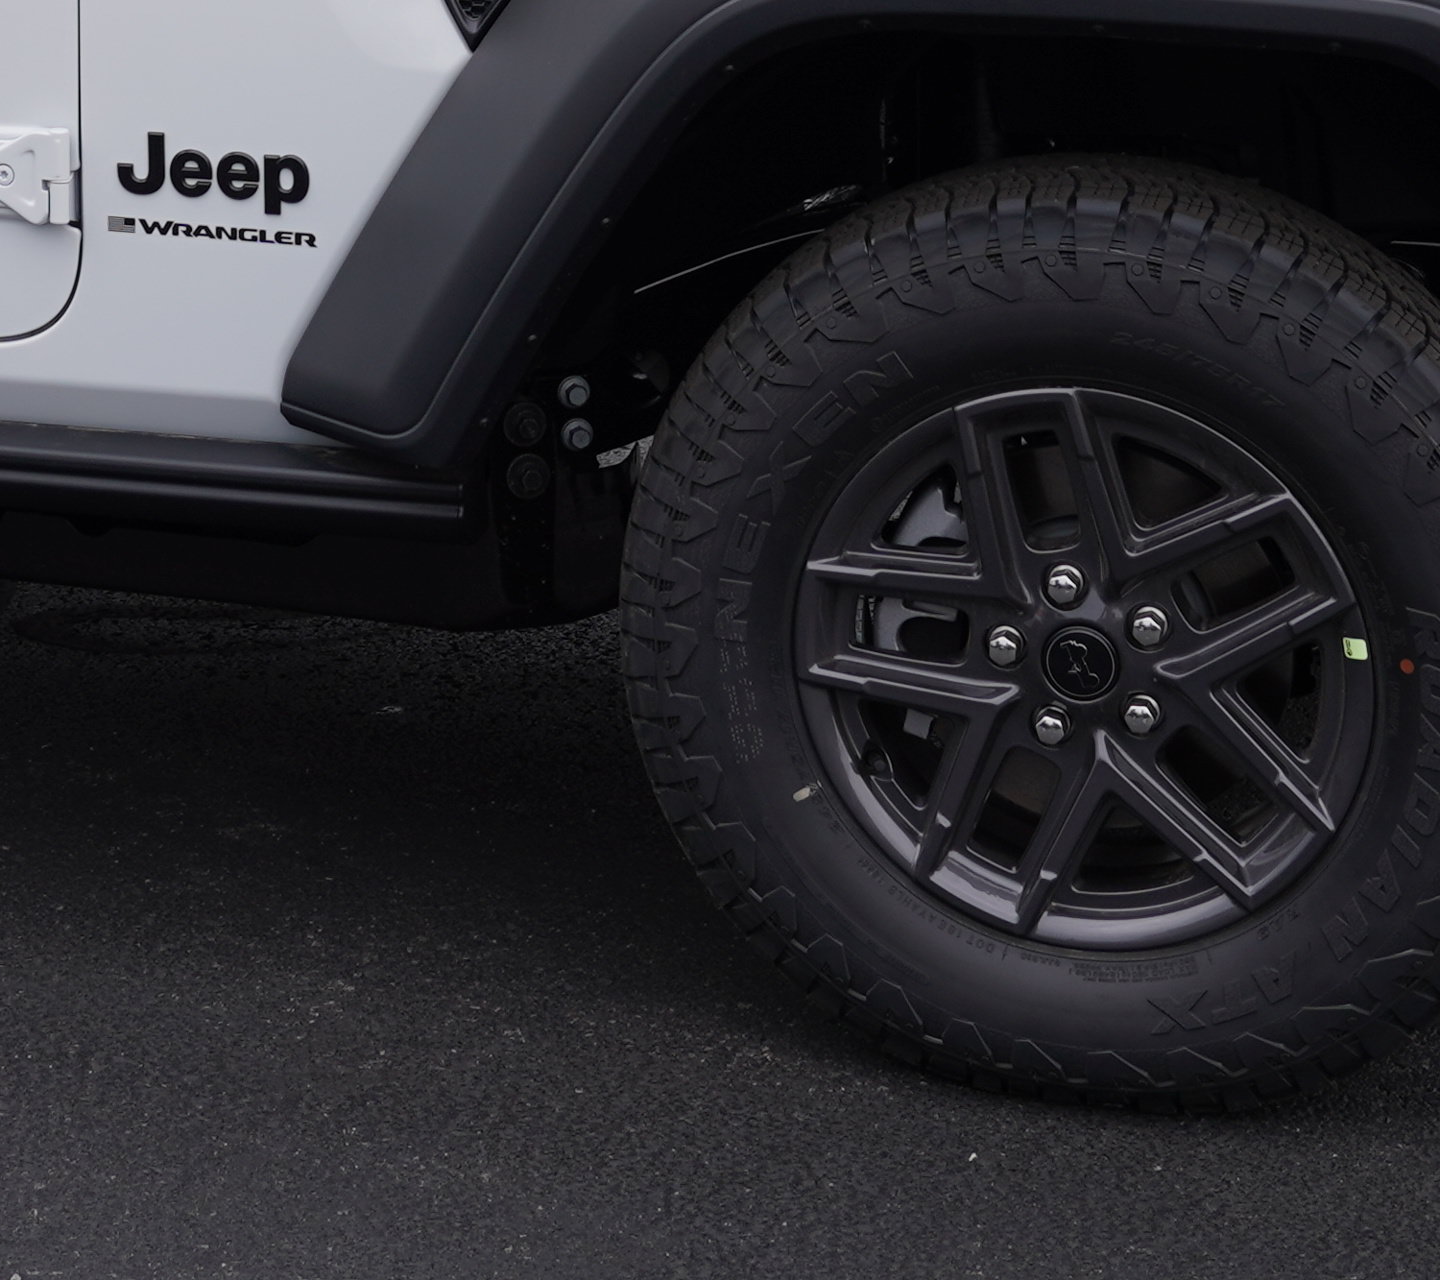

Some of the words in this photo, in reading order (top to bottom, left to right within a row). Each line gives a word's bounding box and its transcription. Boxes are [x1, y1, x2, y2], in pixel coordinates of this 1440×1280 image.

[117, 131, 310, 215] Jeep
[138, 218, 318, 248] WRANGLER
[713, 350, 913, 642] NEXEN
